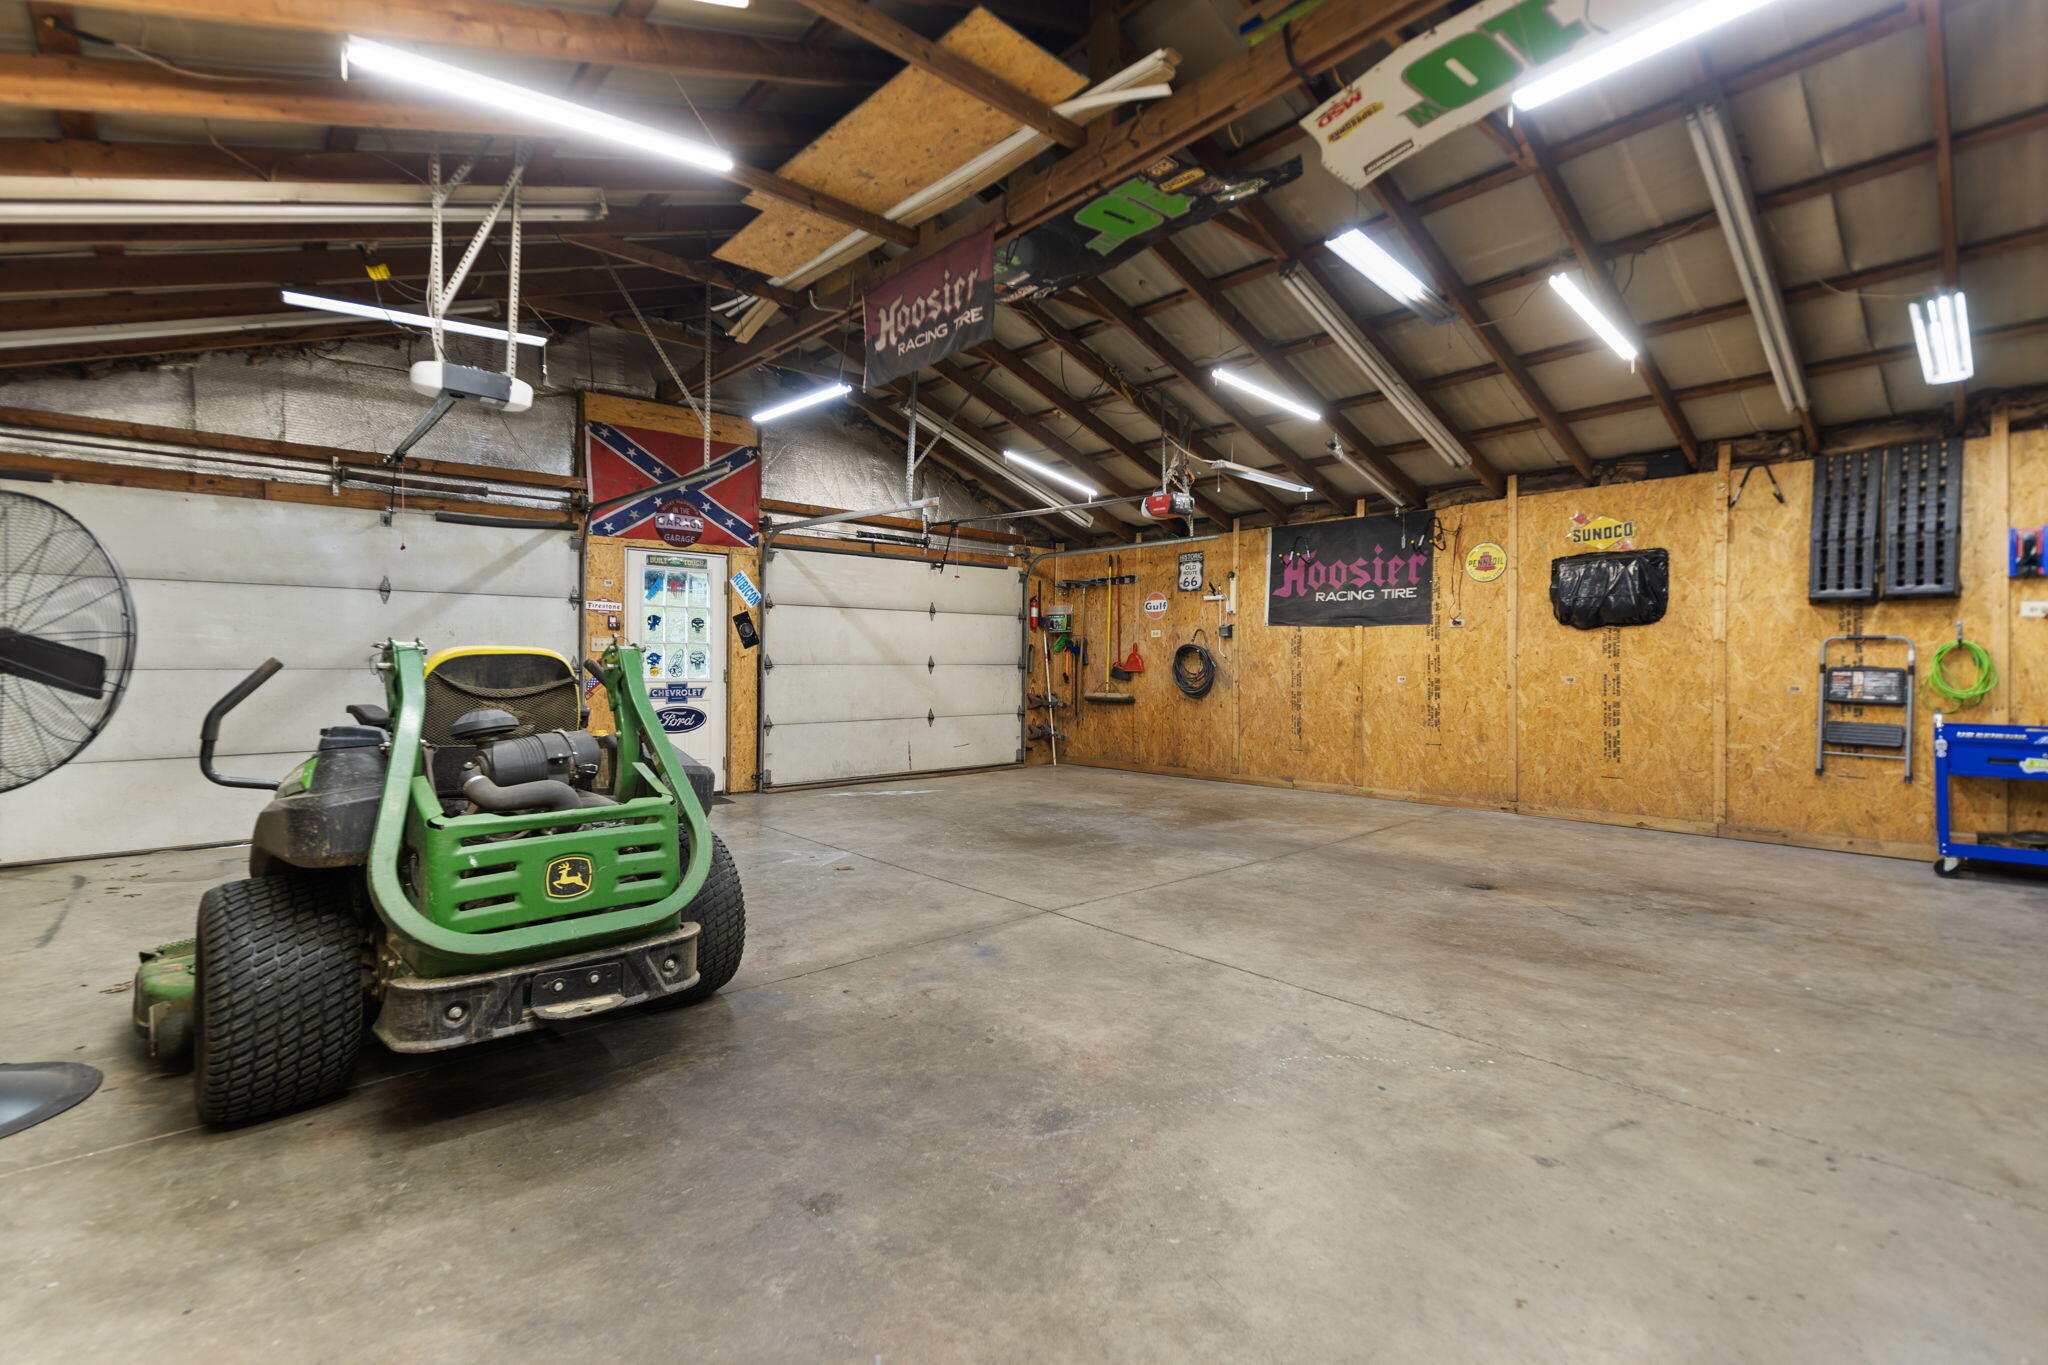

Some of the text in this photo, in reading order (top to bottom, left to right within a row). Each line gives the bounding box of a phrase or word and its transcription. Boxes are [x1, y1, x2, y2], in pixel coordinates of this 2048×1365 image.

[1318, 88, 1362, 128] MSD
[874, 267, 979, 351] Hoosier
[897, 323, 948, 357] RACING
[657, 515, 703, 530] GARAGE
[664, 533, 696, 544] GARAGE
[1573, 521, 1633, 543] SUNOCO
[1180, 552, 1203, 561] HISTORIC
[1468, 557, 1504, 568] PENNZOIL
[1271, 543, 1428, 598] Hoosier
[732, 571, 761, 607] RUBICON
[1183, 576, 1198, 588] 66
[1315, 587, 1418, 602] RACING TIRE
[588, 602, 620, 610] Firestone
[1145, 601, 1167, 611] Gulf
[652, 688, 702, 697] CHEVROLET
[660, 711, 696, 727] Ford
